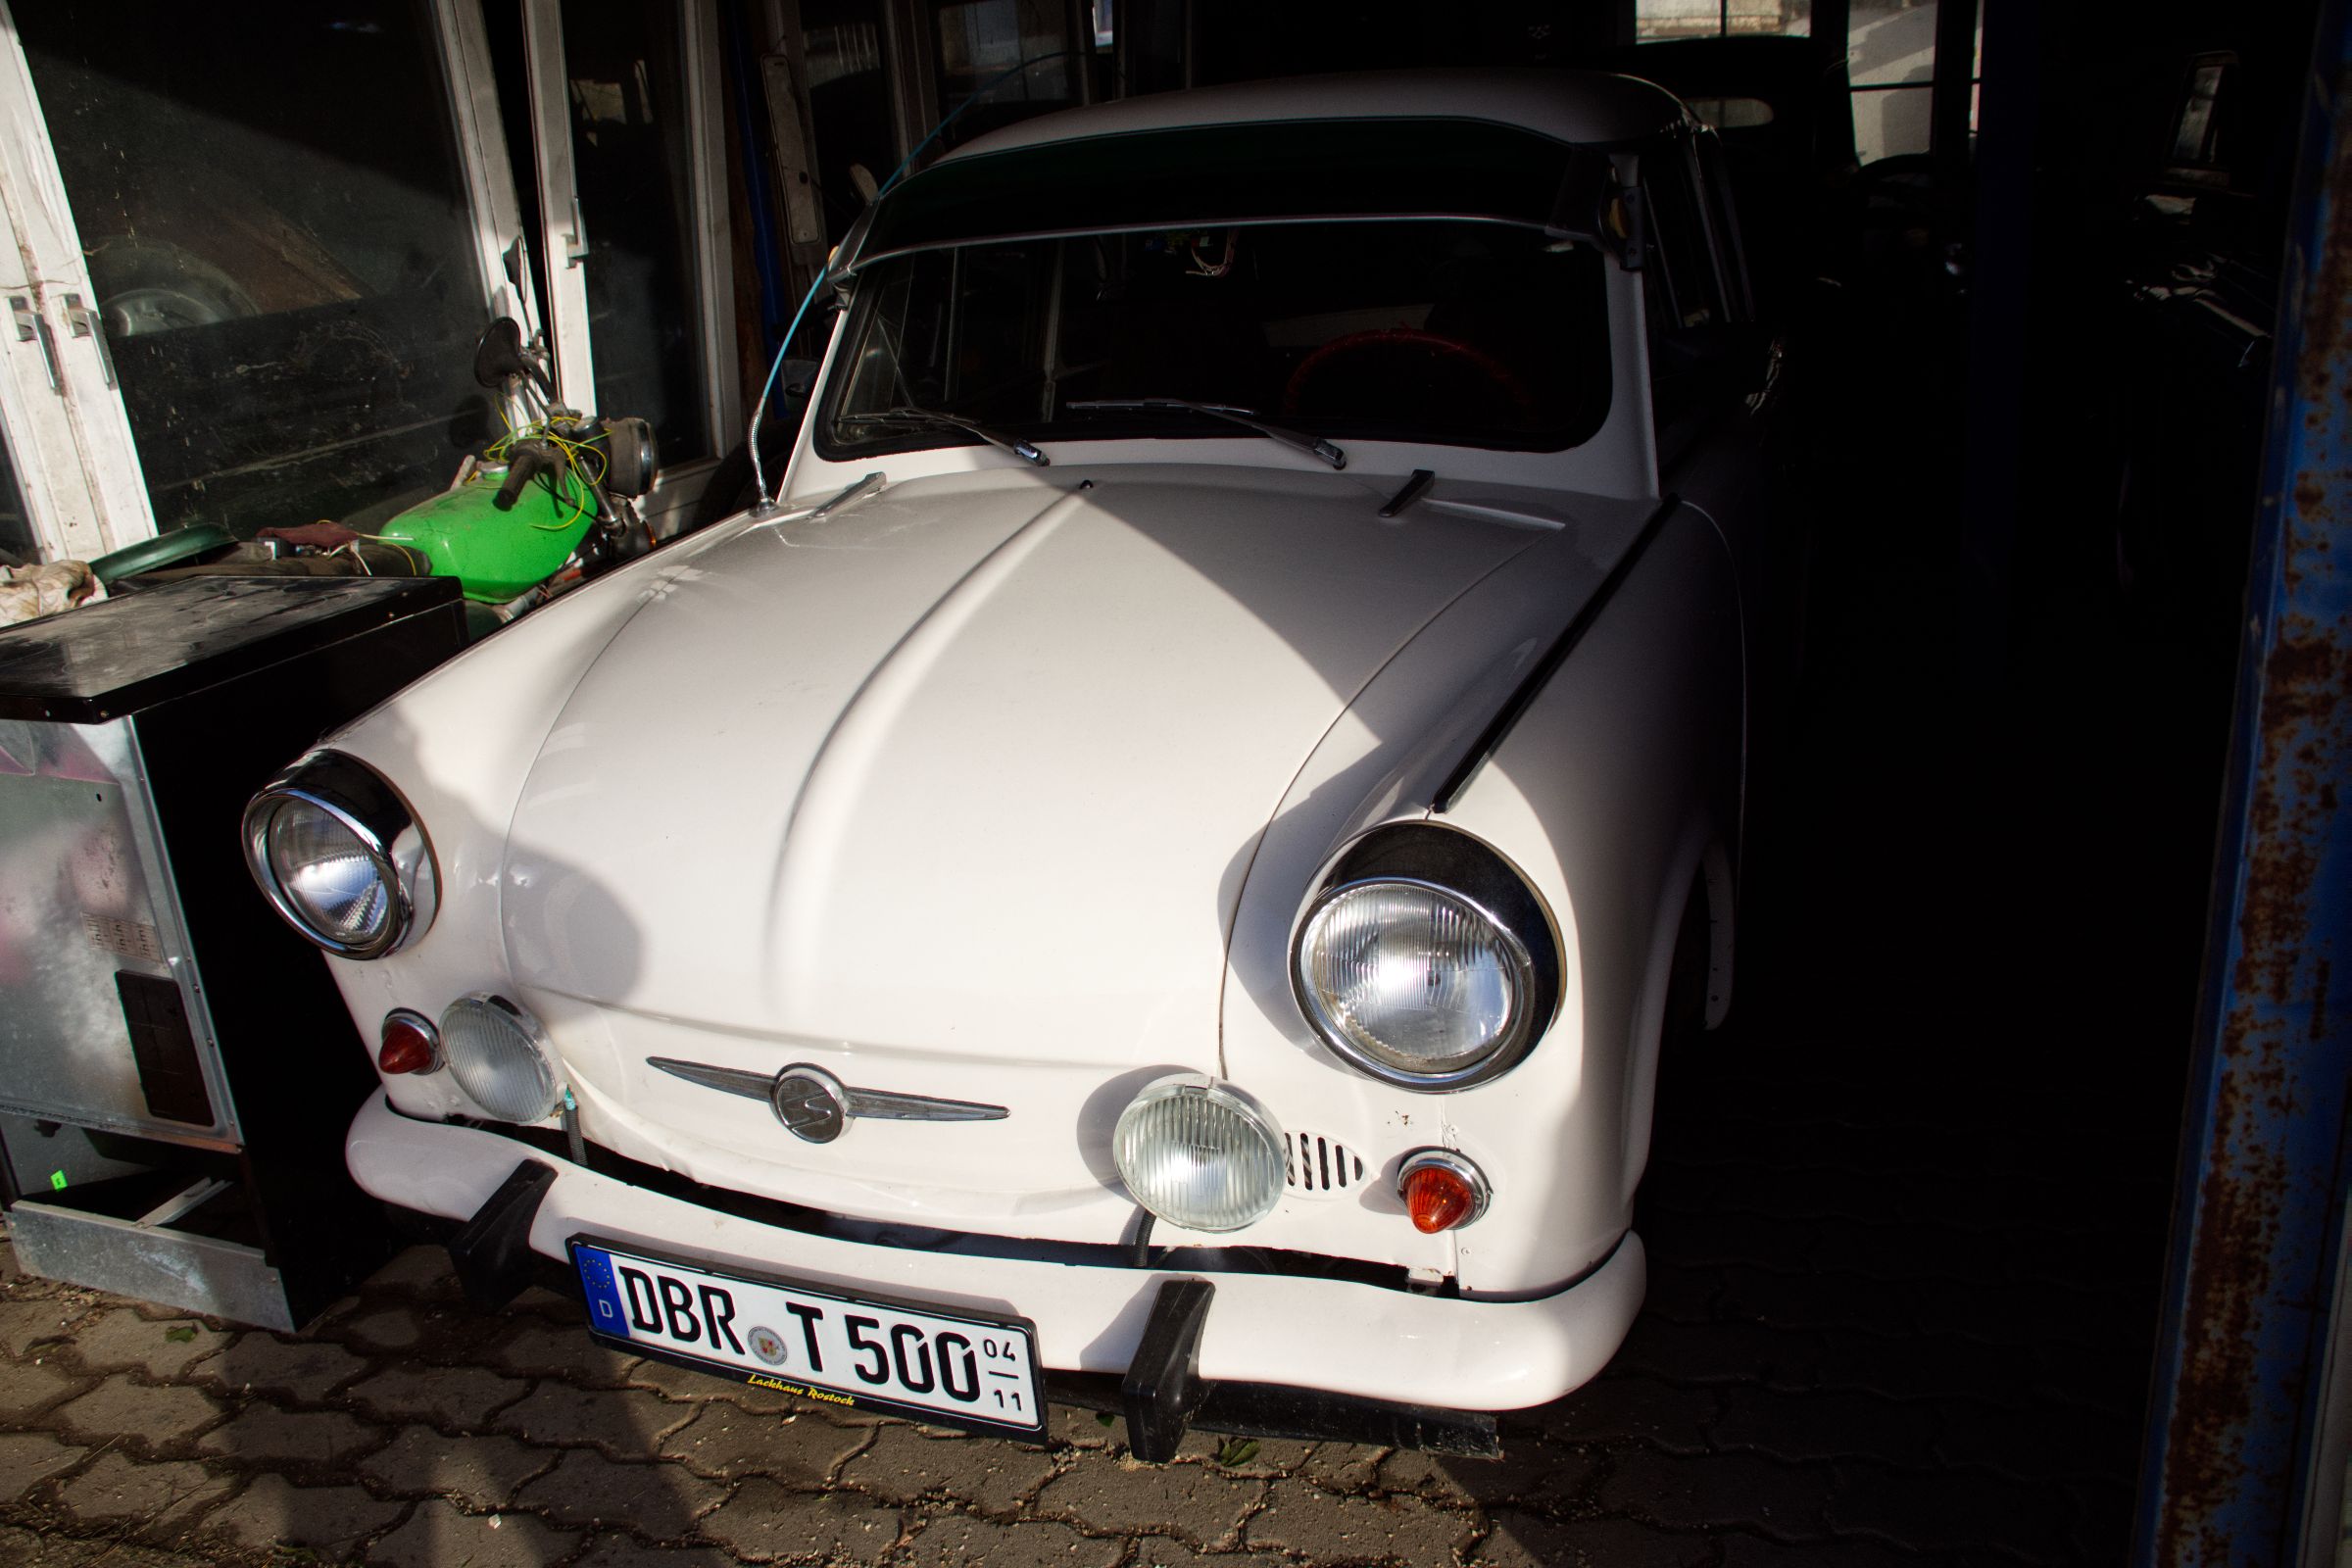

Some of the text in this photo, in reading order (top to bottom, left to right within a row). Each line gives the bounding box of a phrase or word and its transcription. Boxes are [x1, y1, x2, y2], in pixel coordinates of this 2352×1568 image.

[598, 1299, 613, 1318] D
[618, 1265, 746, 1355] DBR
[786, 1301, 824, 1372] T
[845, 1314, 981, 1402] 500
[983, 1339, 1016, 1362] 04
[747, 1373, 856, 1406] Lackhaus Rostock
[994, 1389, 1022, 1412] 11
